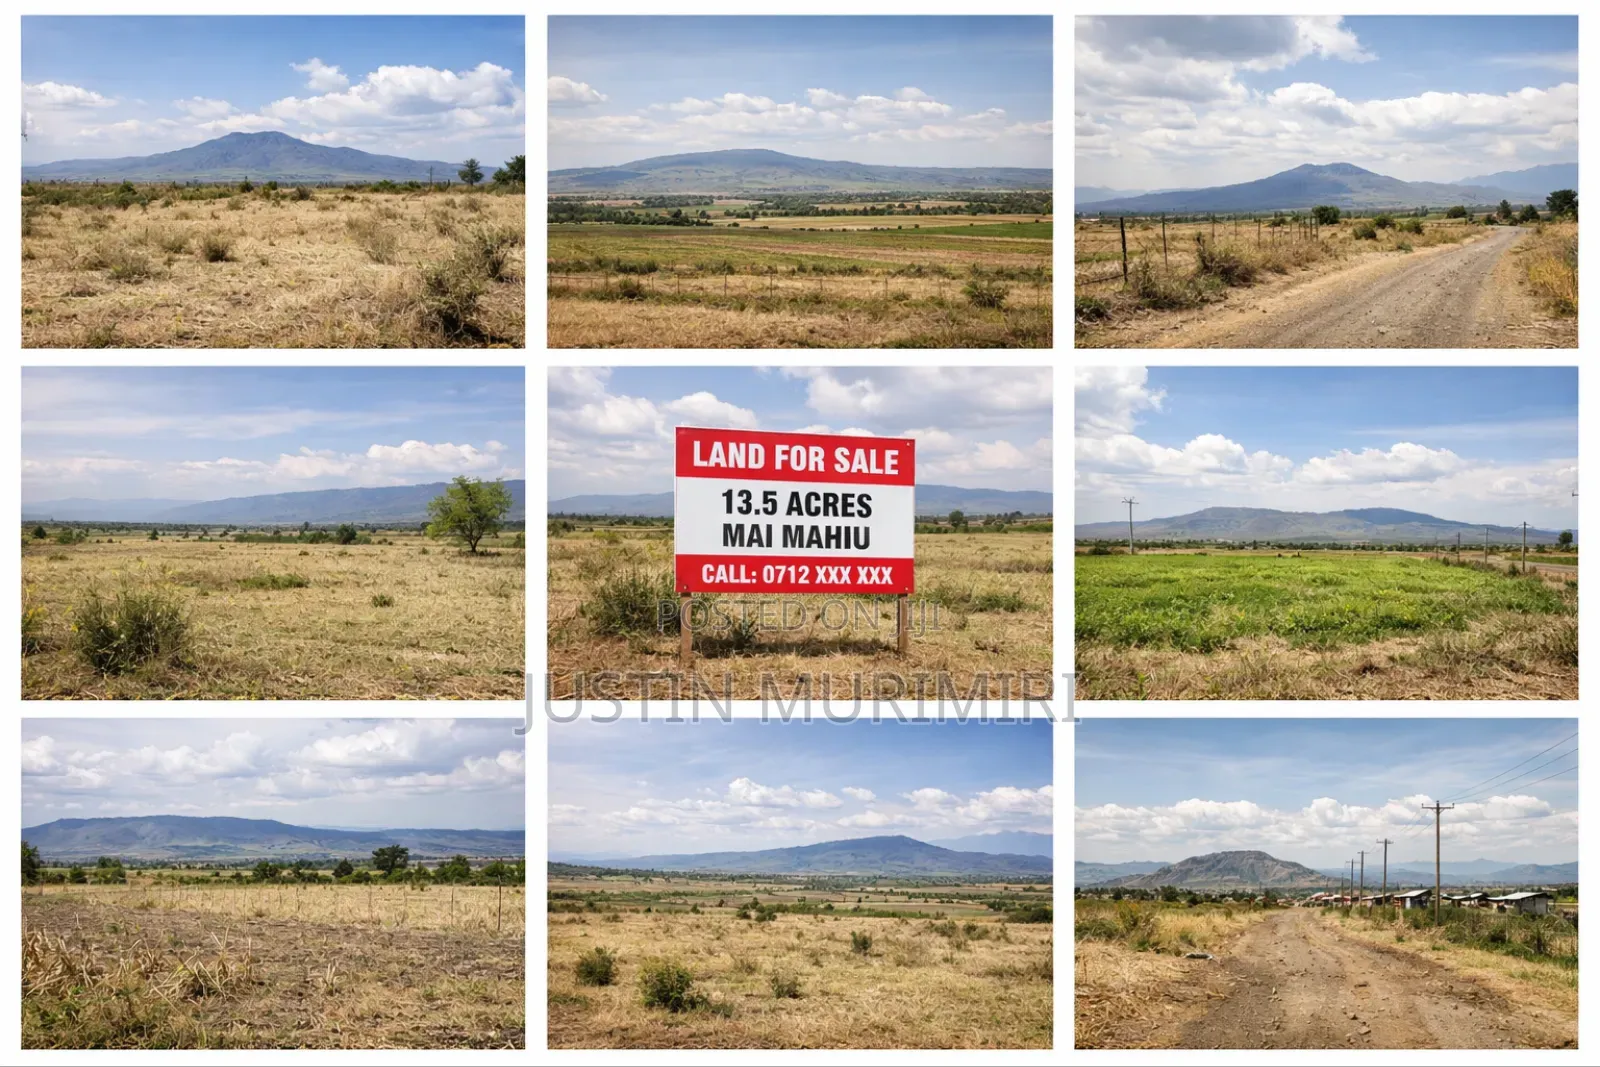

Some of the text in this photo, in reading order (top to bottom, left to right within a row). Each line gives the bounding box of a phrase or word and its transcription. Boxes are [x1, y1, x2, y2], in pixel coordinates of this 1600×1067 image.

[693, 440, 899, 475] LAND FOR SALE
[722, 488, 872, 518] 13.5 ACRES
[722, 523, 871, 550] MAI MAHIU
[702, 564, 893, 585] CALL: 0712 XXX XXX
